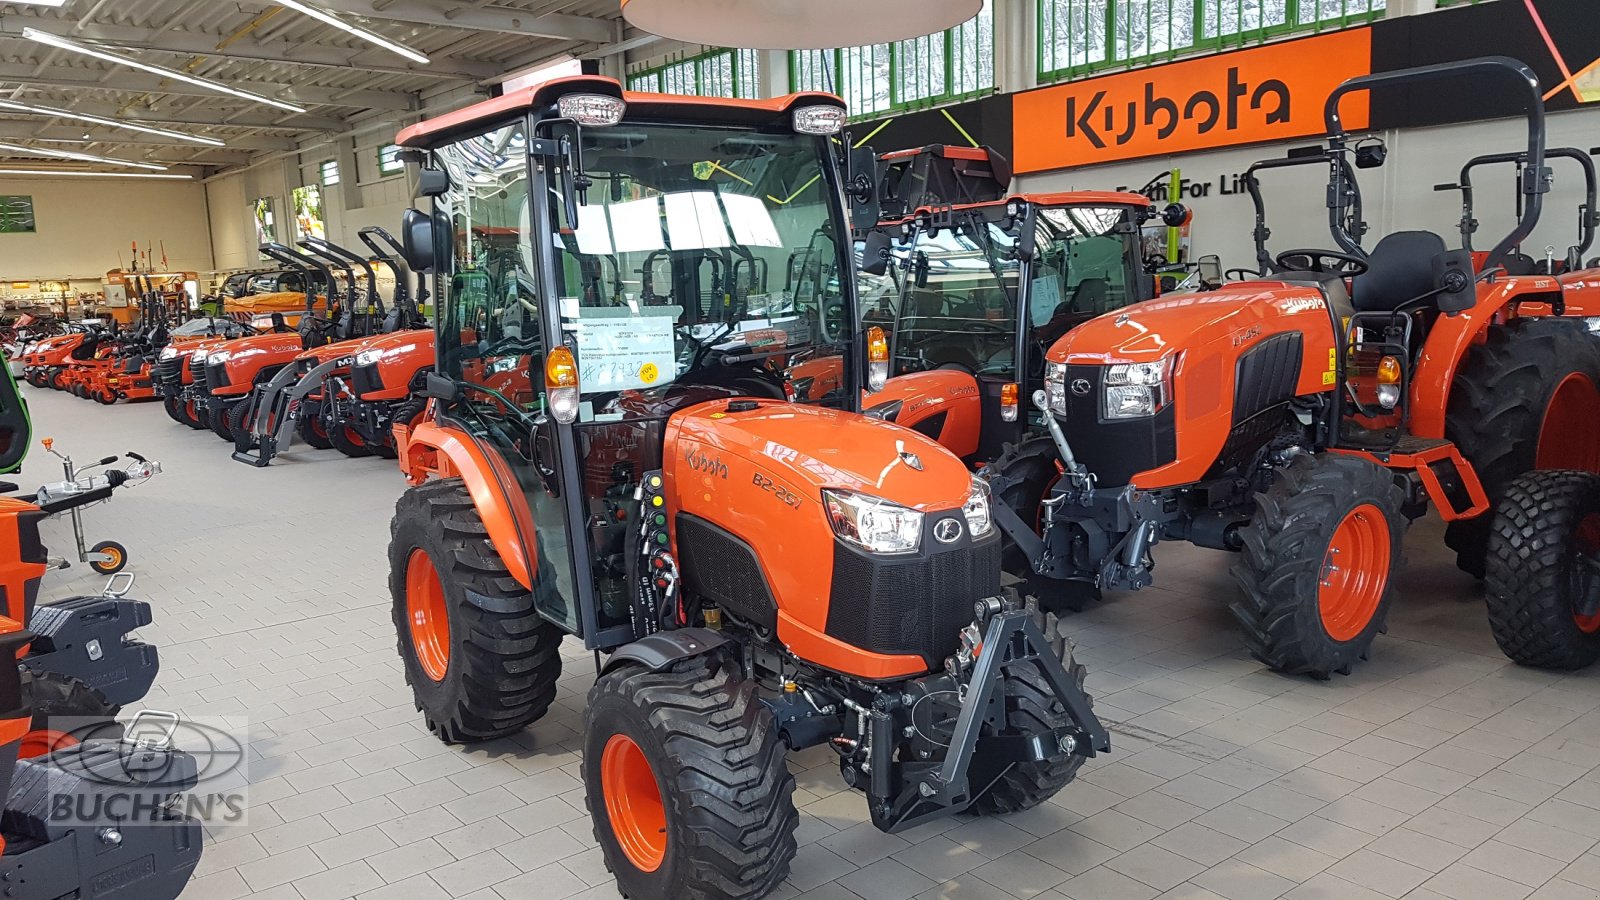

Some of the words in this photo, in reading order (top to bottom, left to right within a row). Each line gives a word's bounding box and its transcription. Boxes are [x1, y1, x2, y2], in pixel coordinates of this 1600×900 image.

[1066, 67, 1291, 149] Kubota
[1179, 178, 1211, 199] For
[1286, 296, 1326, 311] Kubota
[686, 448, 729, 479] Kubota
